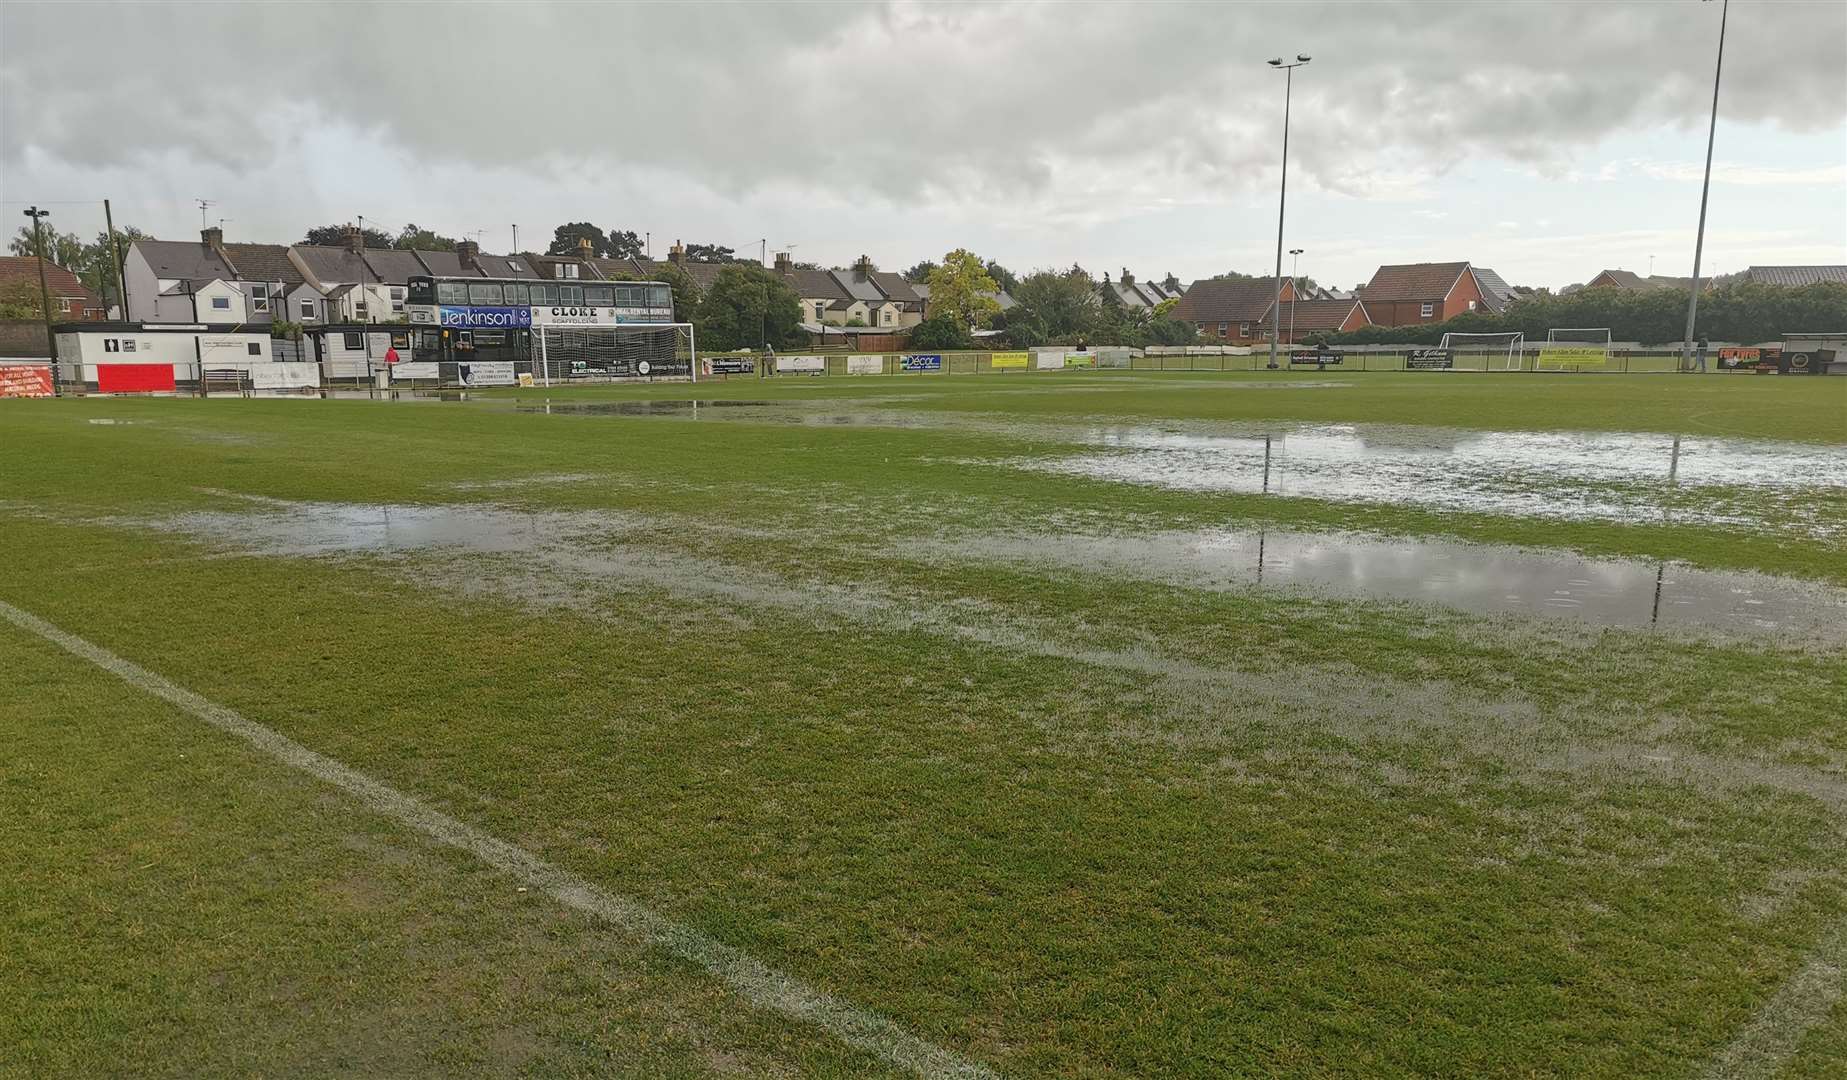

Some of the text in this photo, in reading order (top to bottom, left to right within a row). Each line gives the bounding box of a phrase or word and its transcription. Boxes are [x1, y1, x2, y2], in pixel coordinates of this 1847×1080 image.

[551, 307, 597, 316] CLOKE
[442, 309, 513, 325] Jenkinson
[907, 355, 935, 365] Décor
